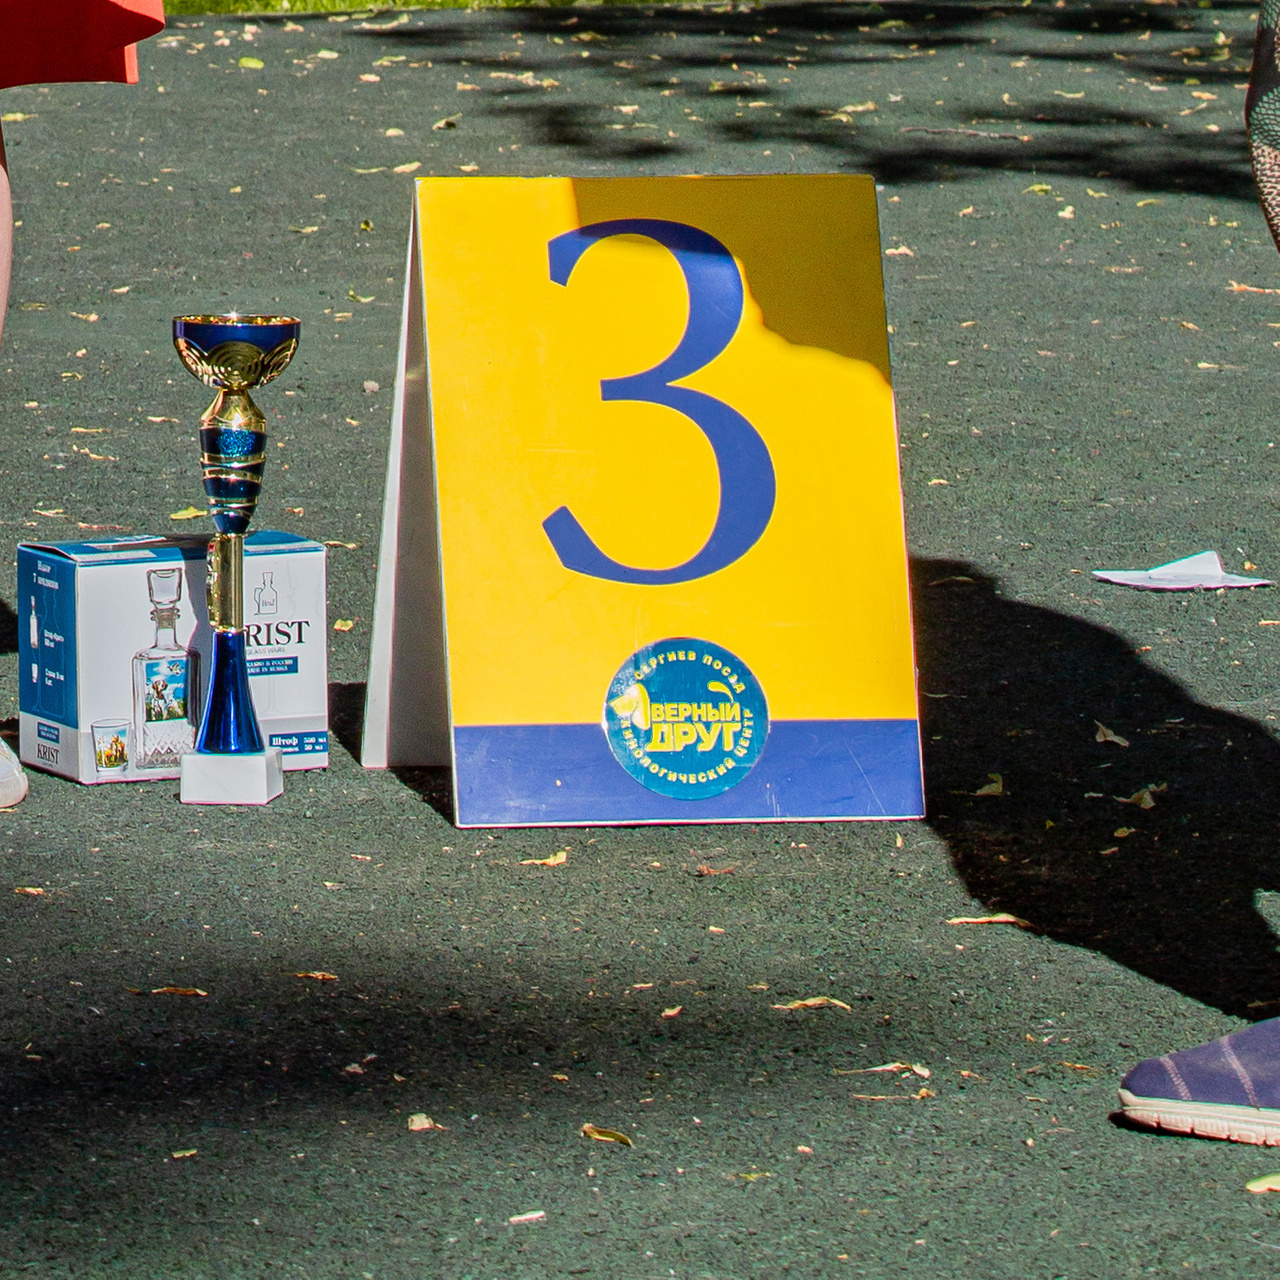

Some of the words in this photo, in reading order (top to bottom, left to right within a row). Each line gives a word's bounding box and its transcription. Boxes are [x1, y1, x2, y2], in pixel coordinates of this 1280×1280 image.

[541, 218, 777, 586] 3
[243, 620, 310, 647] RIST
[634, 650, 696, 680] СЕРГИЕВ
[703, 654, 746, 694] ПОСАД
[650, 702, 741, 722] ВЕРНЫЙ
[272, 736, 299, 746] Штоф
[621, 719, 737, 784] КИНОЛОГИЧЕСКИЙ
[734, 708, 754, 758] ЦЕНТР
[645, 722, 742, 752] ДРУГ
[37, 743, 60, 764] KRIST
